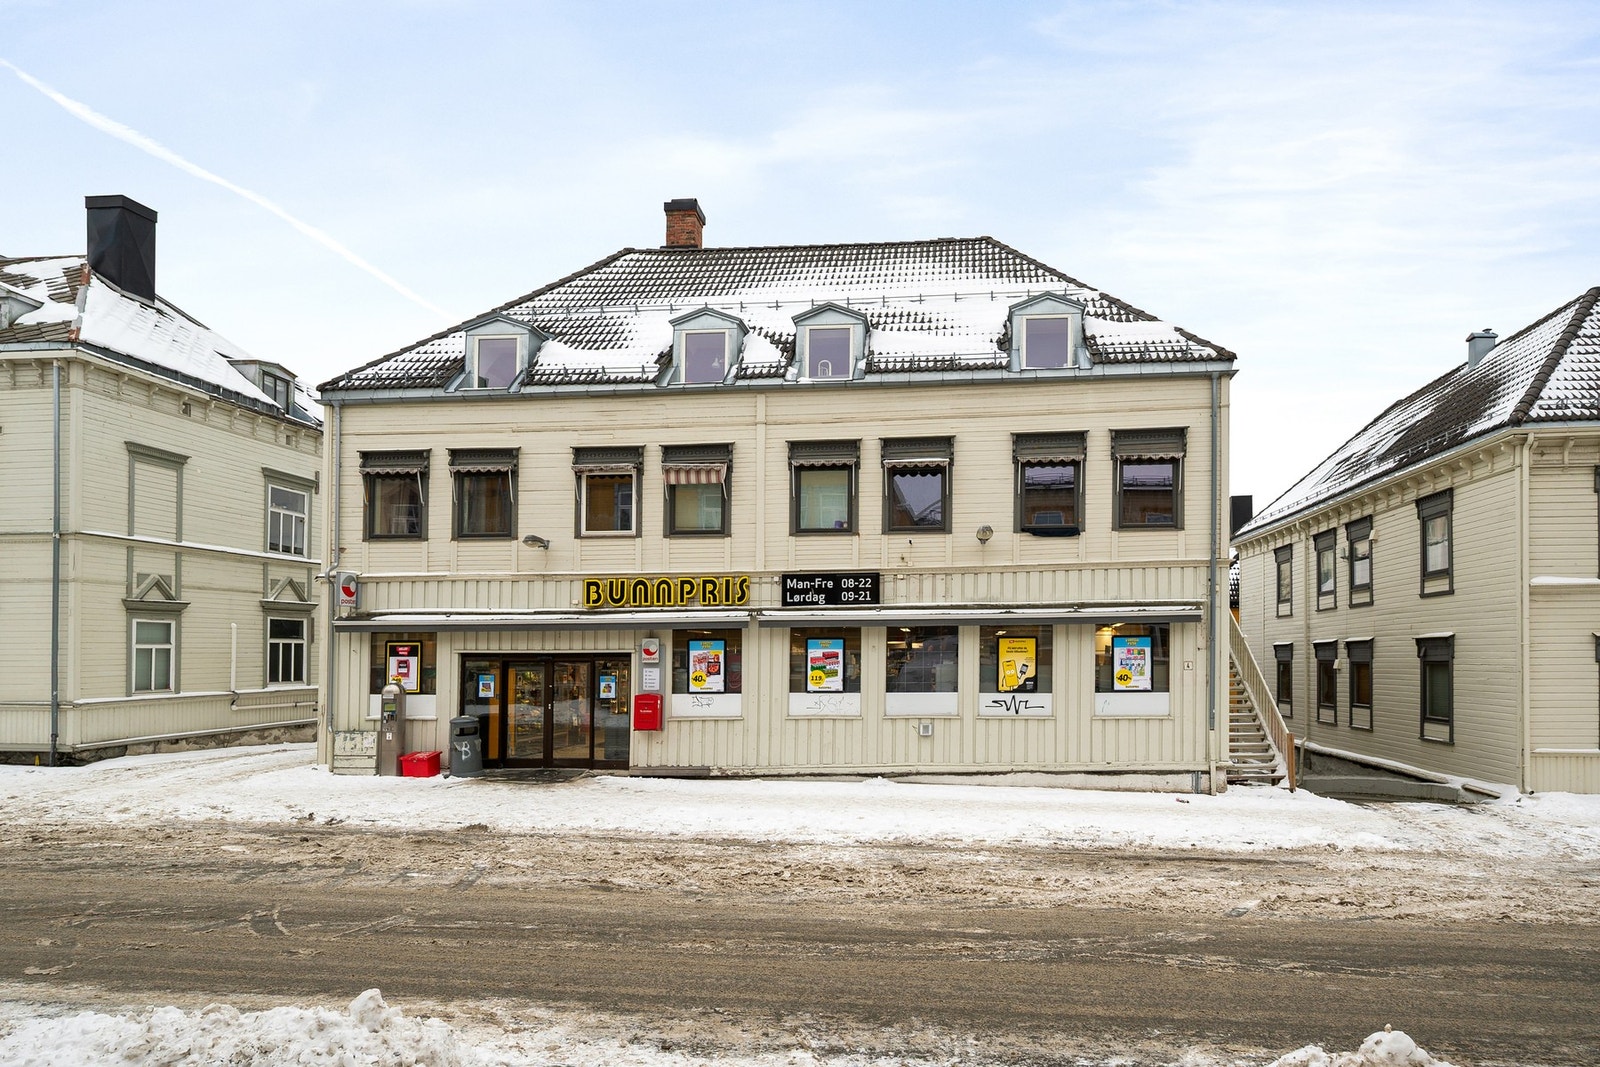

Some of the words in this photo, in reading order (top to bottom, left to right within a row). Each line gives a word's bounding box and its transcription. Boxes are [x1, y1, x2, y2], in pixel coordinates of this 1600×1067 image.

[786, 578, 834, 589] Man-Fre
[841, 578, 872, 588] 08-22
[583, 576, 750, 608] BUNNPRIS
[786, 591, 826, 604] Lørdag
[841, 591, 871, 601] 09-21
